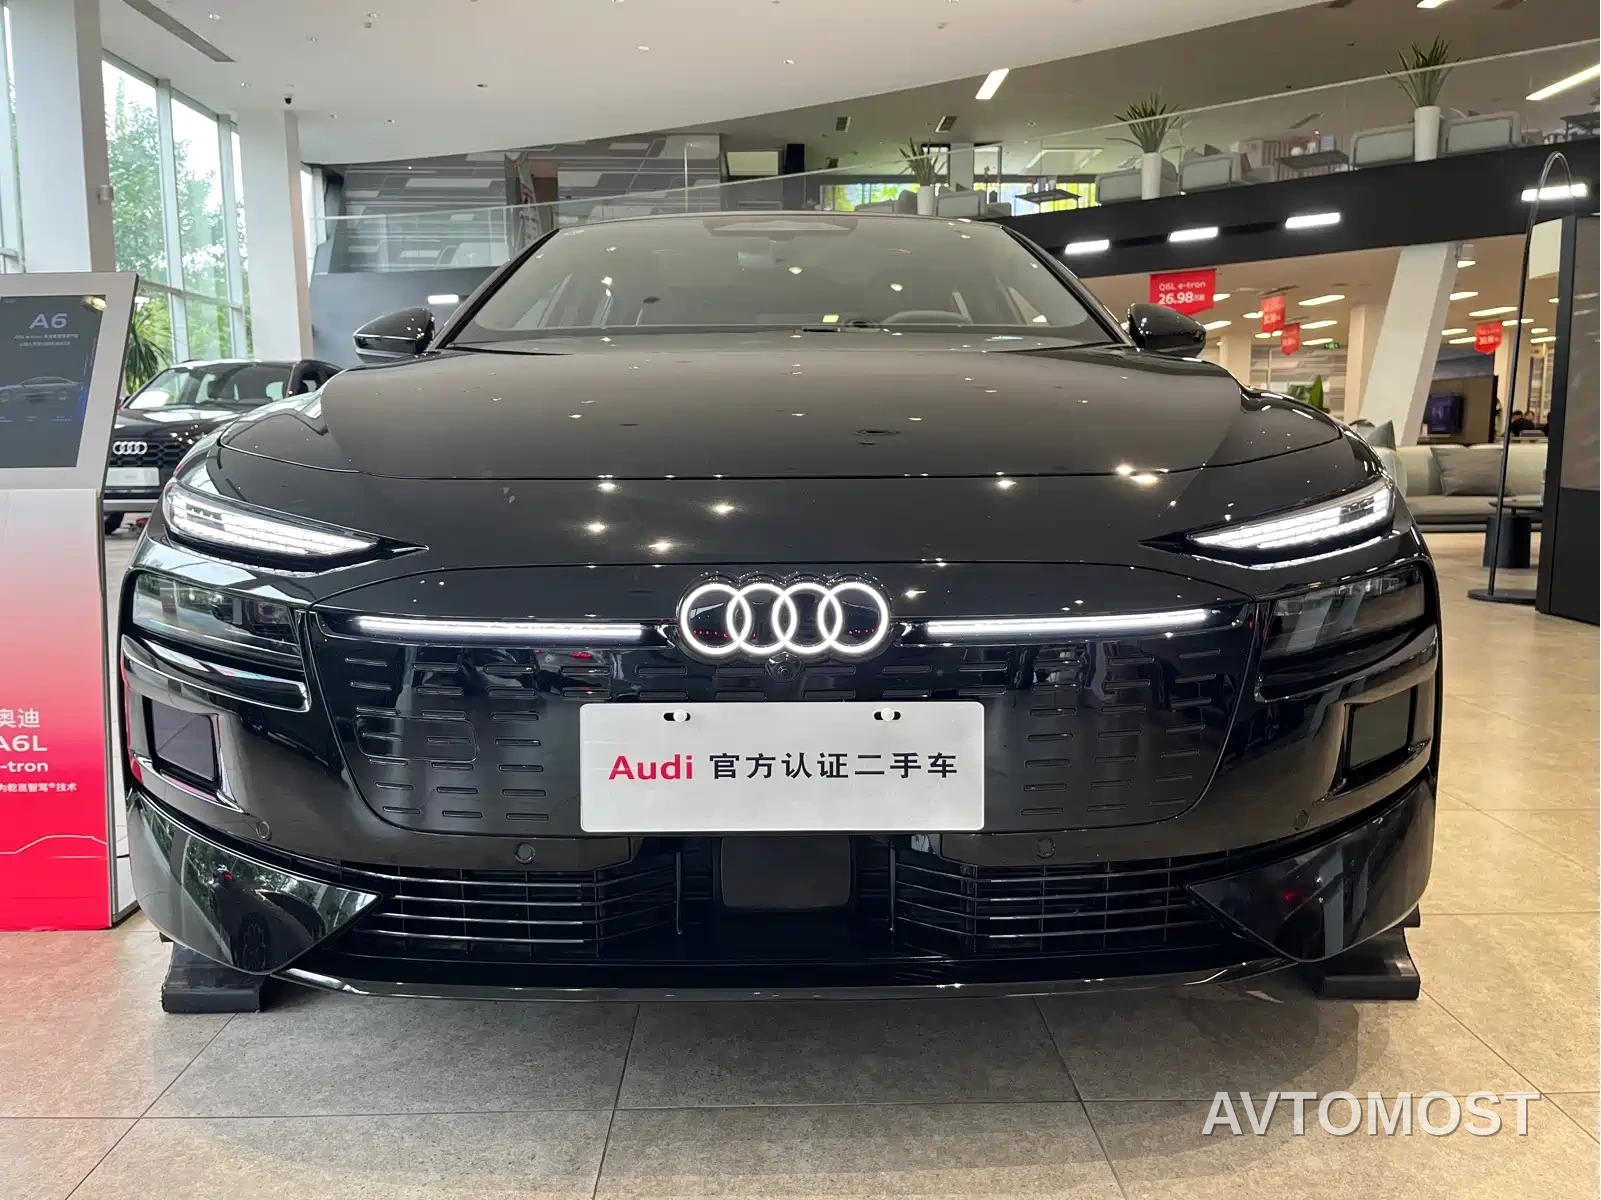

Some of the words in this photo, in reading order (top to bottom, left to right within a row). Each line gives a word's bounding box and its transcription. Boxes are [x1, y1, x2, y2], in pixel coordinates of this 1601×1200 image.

[1178, 281, 1206, 290] e-tron
[29, 313, 67, 329] A6
[0, 708, 40, 729] 奥迪
[0, 735, 48, 752] A6L
[608, 754, 693, 780] Audi
[709, 752, 958, 779] 官方认证二手车
